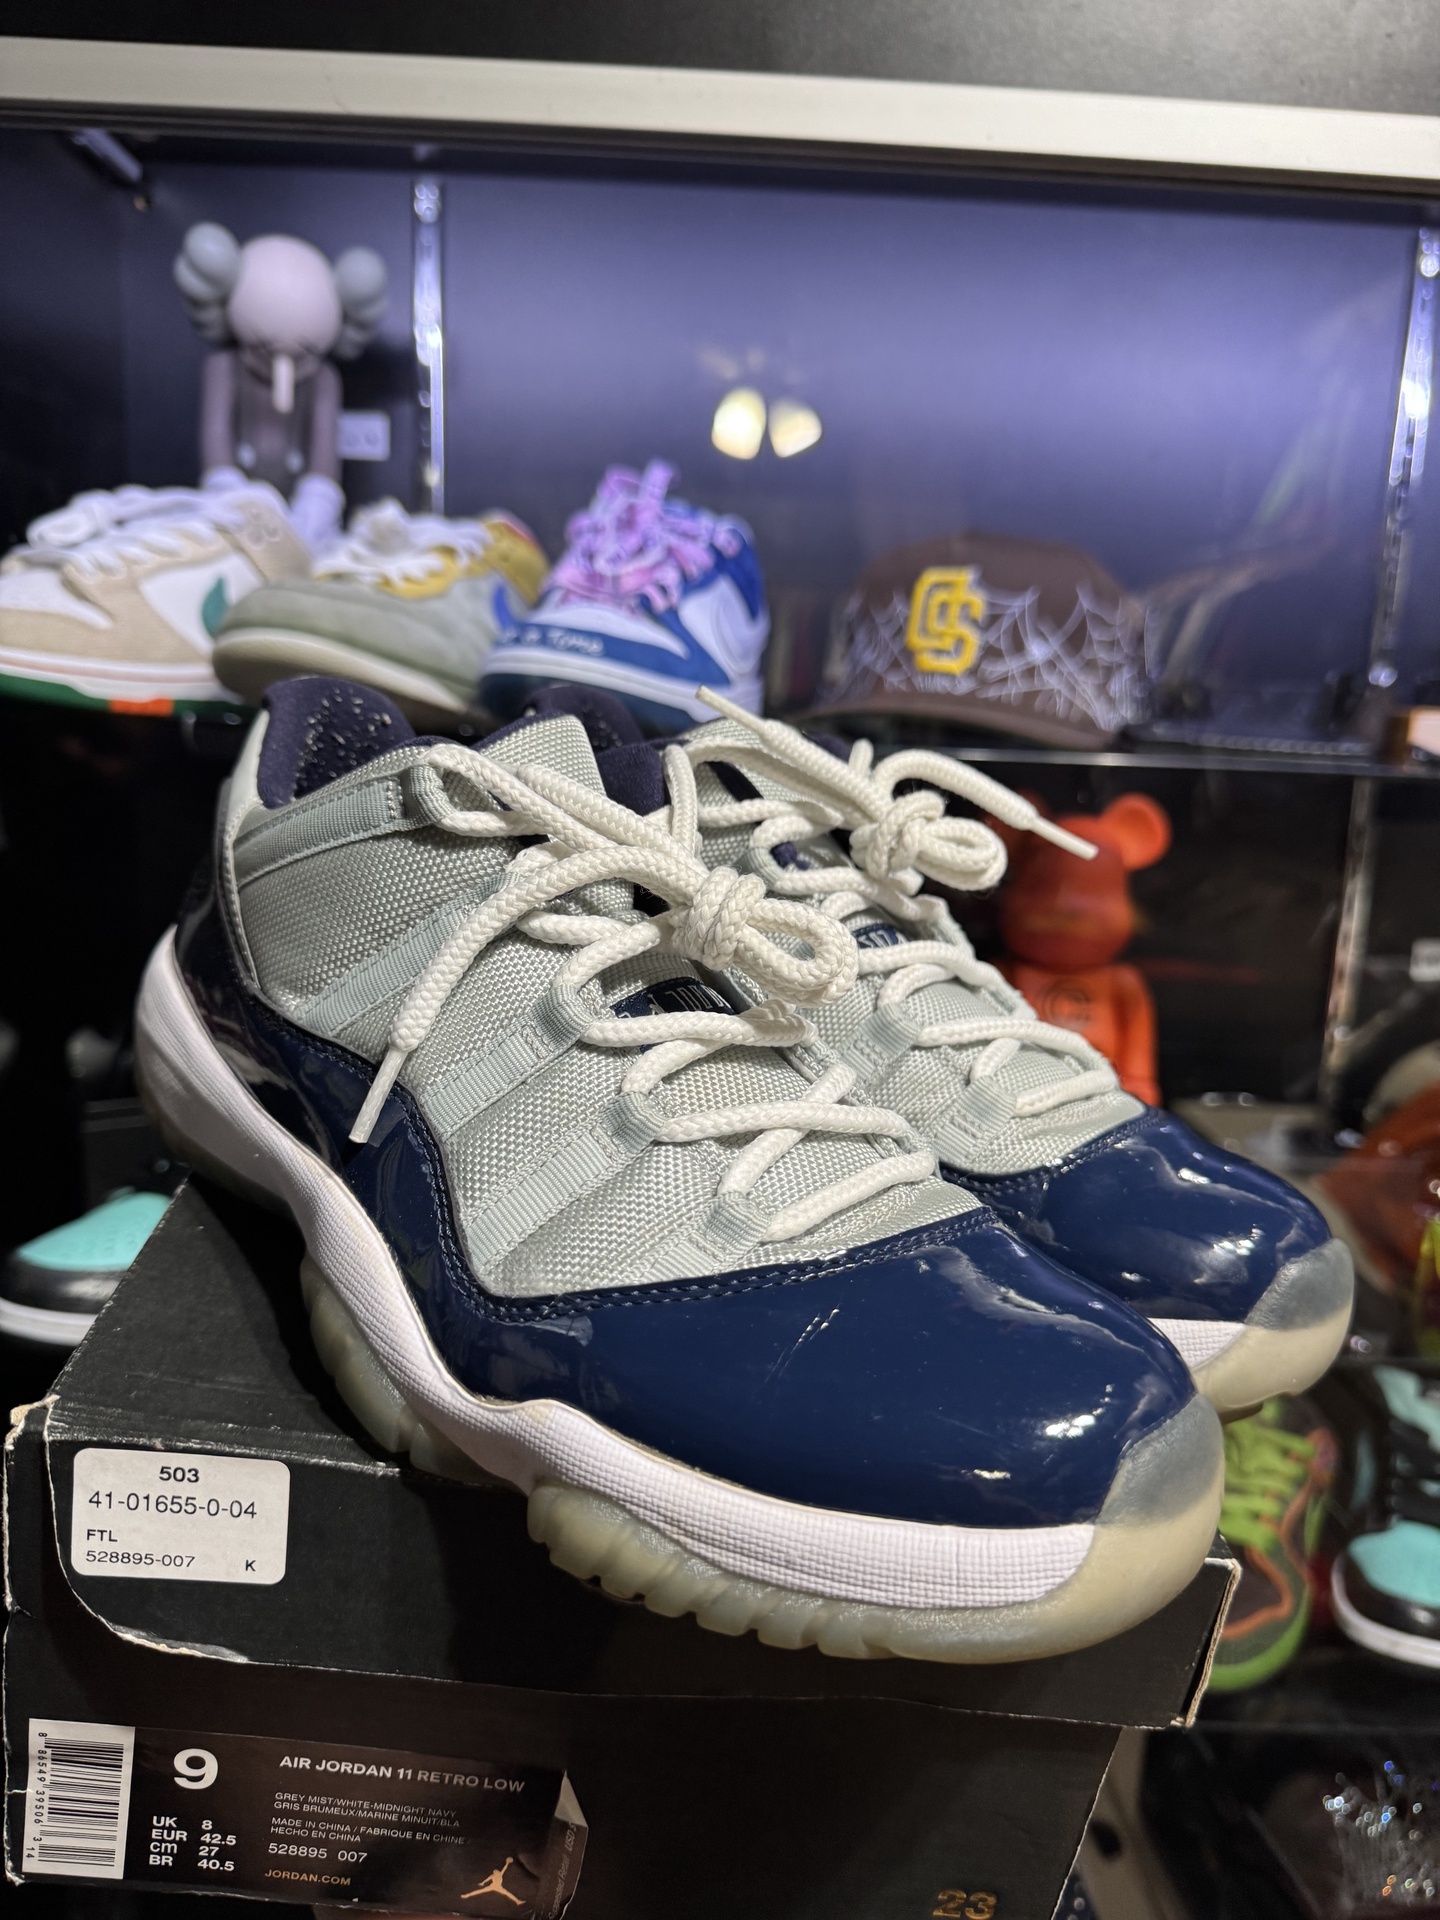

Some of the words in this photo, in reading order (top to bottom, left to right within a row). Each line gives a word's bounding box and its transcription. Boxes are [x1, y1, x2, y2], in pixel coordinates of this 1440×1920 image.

[158, 1466, 200, 1483] 503
[88, 1491, 258, 1519] 41-01655-0-04
[86, 1529, 118, 1543] FTL
[85, 1550, 196, 1568] 528895-007
[245, 1560, 256, 1572] K
[173, 1748, 219, 1790] 9
[279, 1755, 312, 1770] AIR
[315, 1759, 393, 1778] JORDAN
[397, 1767, 413, 1780] 11
[417, 1769, 479, 1787] RETRO
[483, 1778, 526, 1793] LOW
[273, 1801, 300, 1811] GRIS
[303, 1804, 399, 1822] BRUMEUX/MARINE
[274, 1792, 305, 1802] GREY
[428, 1808, 457, 1819] NAVY
[152, 1816, 178, 1828] UK
[201, 1820, 213, 1830] 8
[271, 1817, 302, 1827] MADE
[305, 1820, 316, 1829] IN
[318, 1821, 351, 1832] CHINA
[360, 1826, 413, 1839] FABRIQUE
[415, 1831, 431, 1841] EN
[433, 1833, 465, 1845] CHINE
[151, 1829, 188, 1842] EUR
[200, 1833, 237, 1846] 42.5
[270, 1826, 309, 1837] HECHO
[311, 1830, 326, 1839] EN
[328, 1832, 361, 1843] CHINA
[198, 1845, 220, 1857] 27
[268, 1842, 328, 1859] 528895
[337, 1850, 368, 1863] 007
[149, 1854, 173, 1867] BR
[197, 1859, 235, 1872] 40.5
[264, 1869, 351, 1886] JORDAN.COM
[933, 1888, 997, 1920] 23
